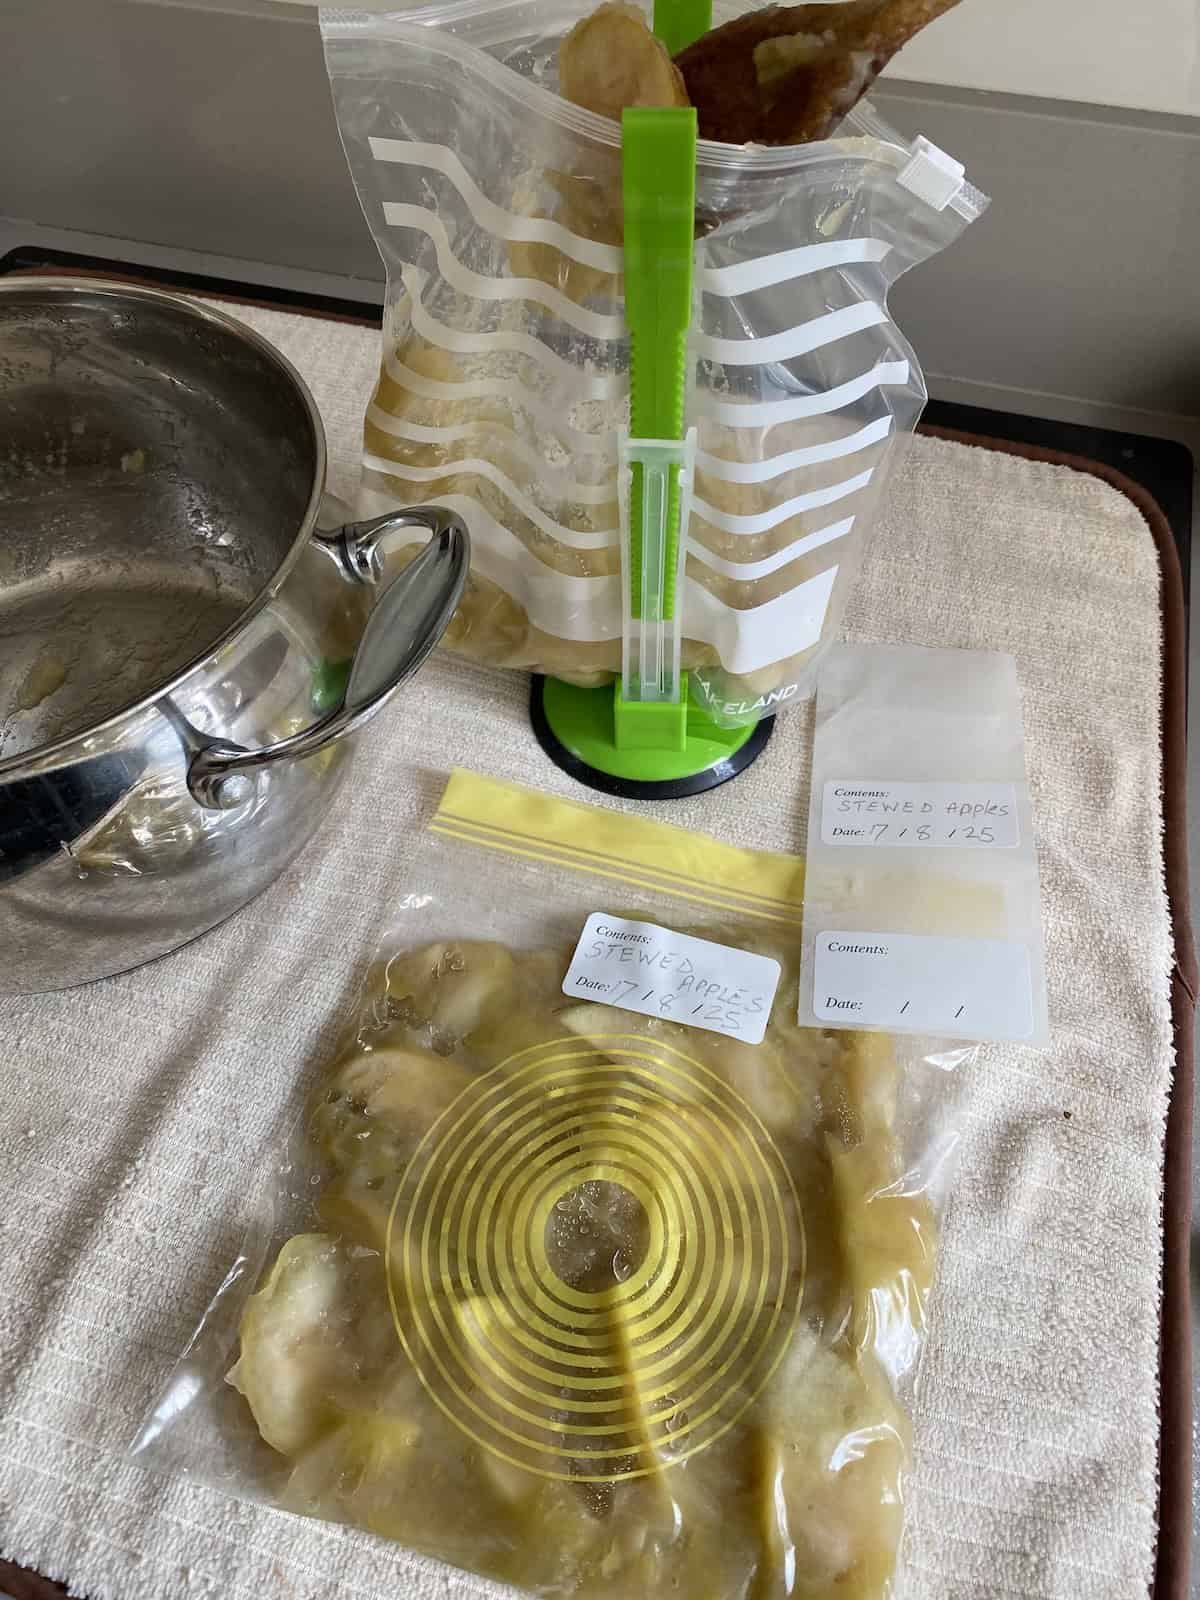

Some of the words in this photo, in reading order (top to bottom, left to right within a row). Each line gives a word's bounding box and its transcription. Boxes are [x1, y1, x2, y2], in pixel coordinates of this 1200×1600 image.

[834, 788, 891, 798] Contents:
[837, 800, 934, 814] STEWED
[832, 827, 866, 837] Date:
[595, 925, 653, 945] Contents:
[828, 941, 889, 956] Contents:
[575, 976, 611, 993] Date:
[584, 941, 694, 974] STEWED
[677, 974, 764, 1014] APPLES
[825, 996, 863, 1011] Date:
